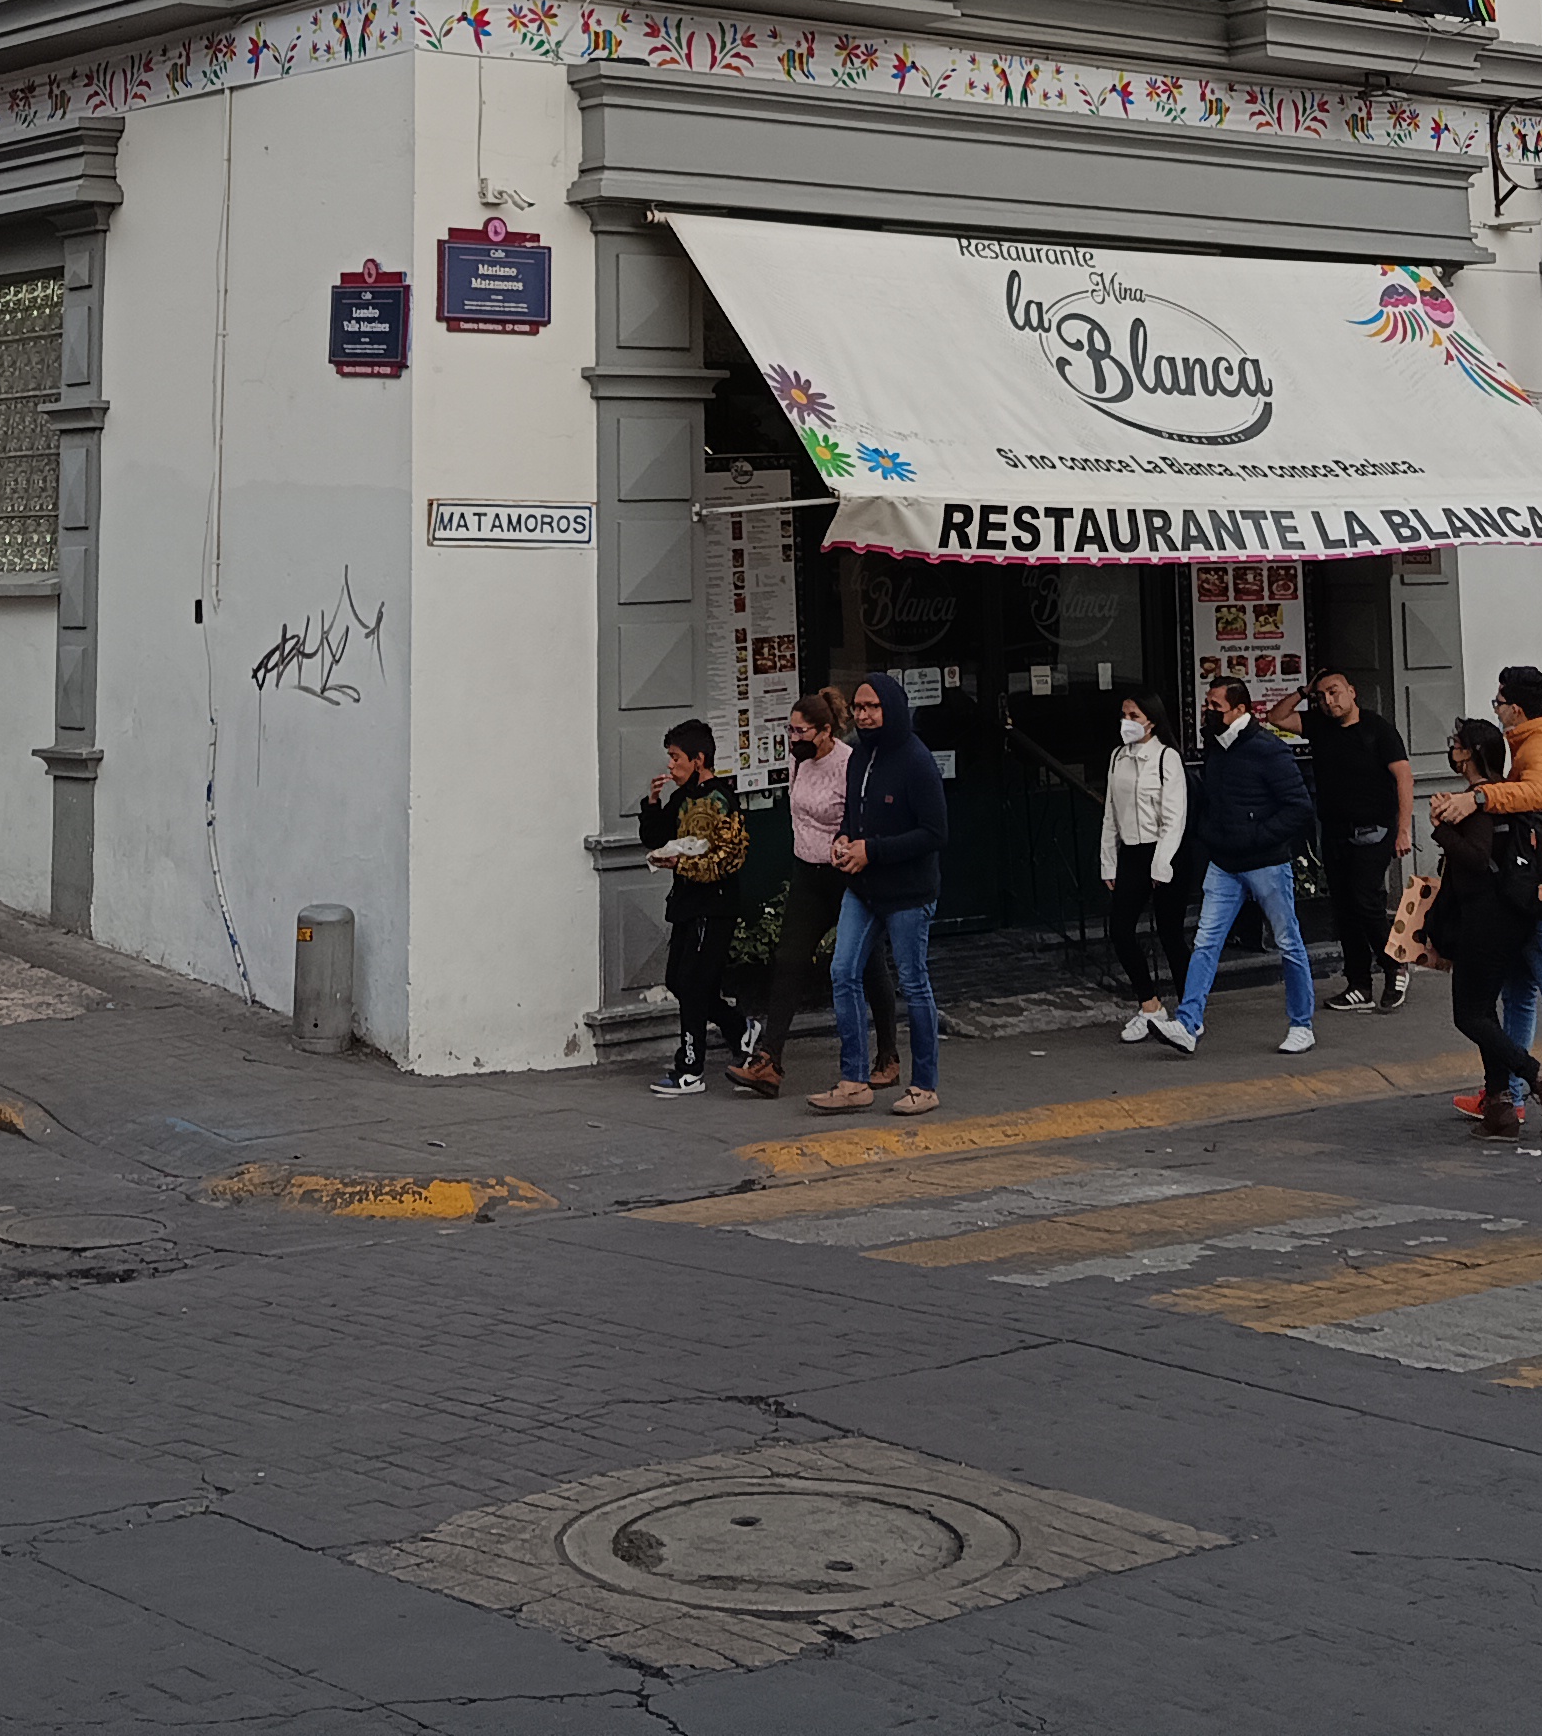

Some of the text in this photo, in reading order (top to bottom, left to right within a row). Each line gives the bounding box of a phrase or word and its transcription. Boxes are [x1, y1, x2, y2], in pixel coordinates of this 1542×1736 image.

[958, 238, 1096, 268] Restaurante
[471, 278, 523, 290] Matamoros
[478, 264, 517, 276] Mariano
[1006, 270, 1052, 334] la
[1089, 272, 1145, 304] Mina
[1055, 312, 1273, 404] Blanca
[996, 448, 1425, 481] Si no conoce La Blanca, no conoce Pachuca.
[437, 511, 587, 534] MATAMOROS
[938, 503, 1305, 553] RESTAURANTE
[1311, 510, 1382, 549] LA
